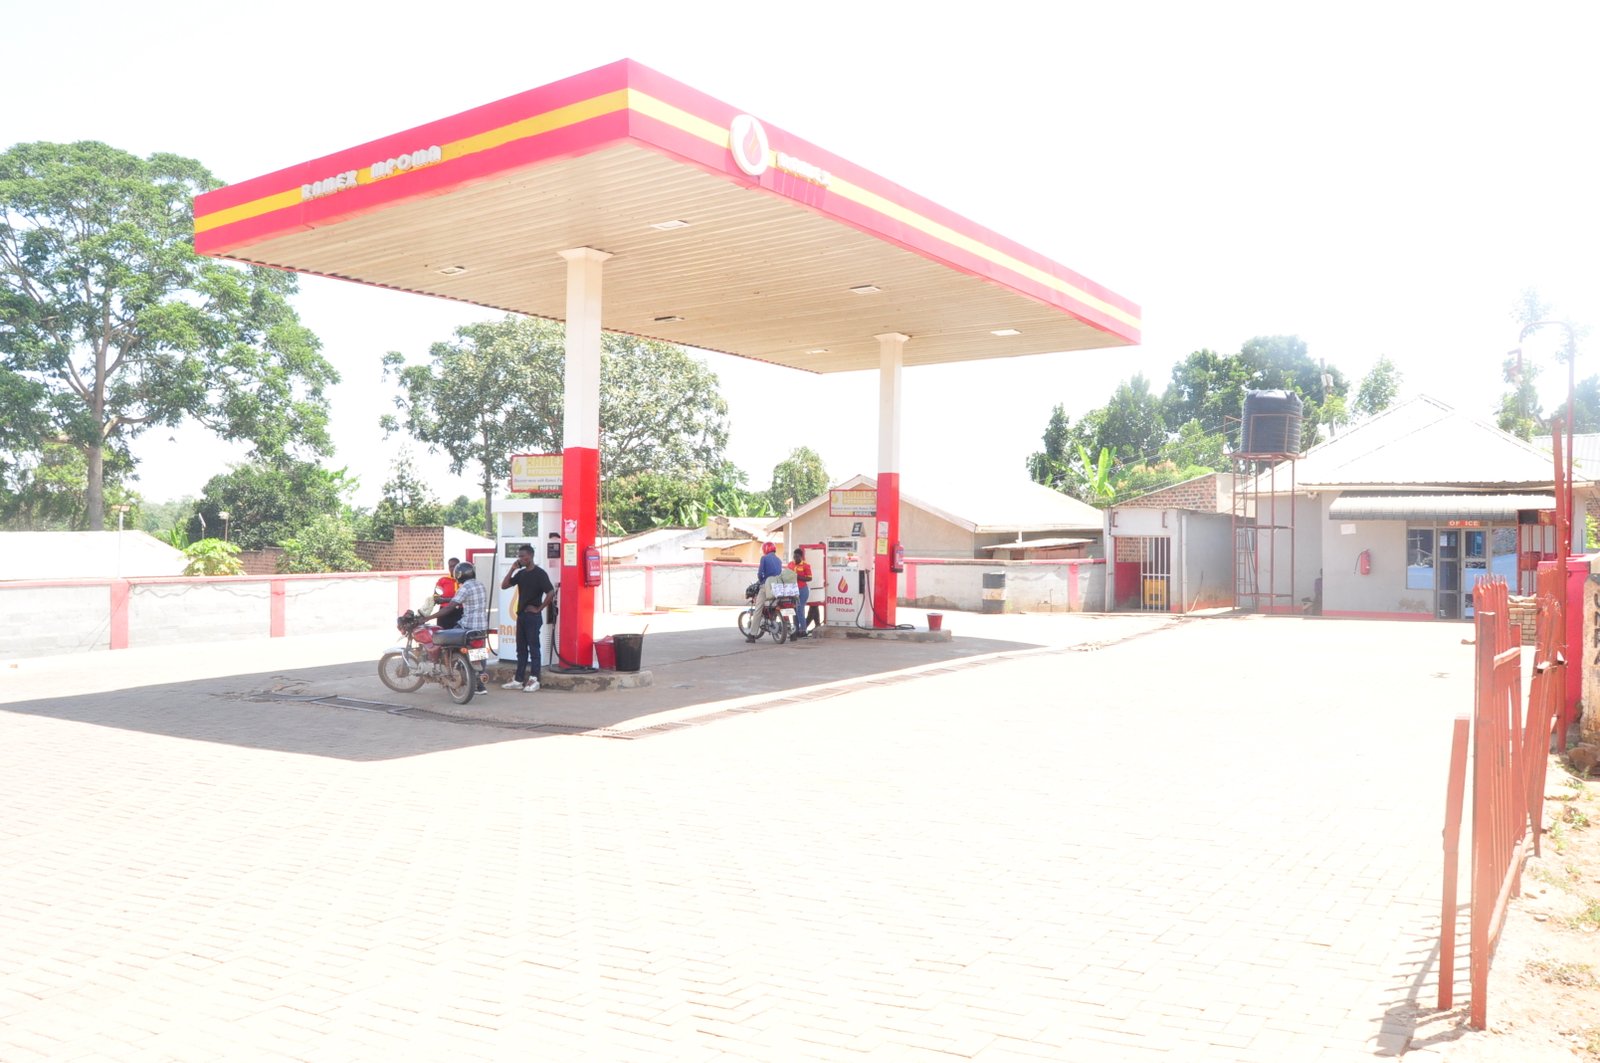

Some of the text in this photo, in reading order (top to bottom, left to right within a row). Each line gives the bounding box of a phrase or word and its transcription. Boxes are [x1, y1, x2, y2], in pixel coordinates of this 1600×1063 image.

[301, 145, 442, 200] RAMEX MPOMA
[827, 596, 853, 605] RAMEX
[499, 624, 516, 636] RA
